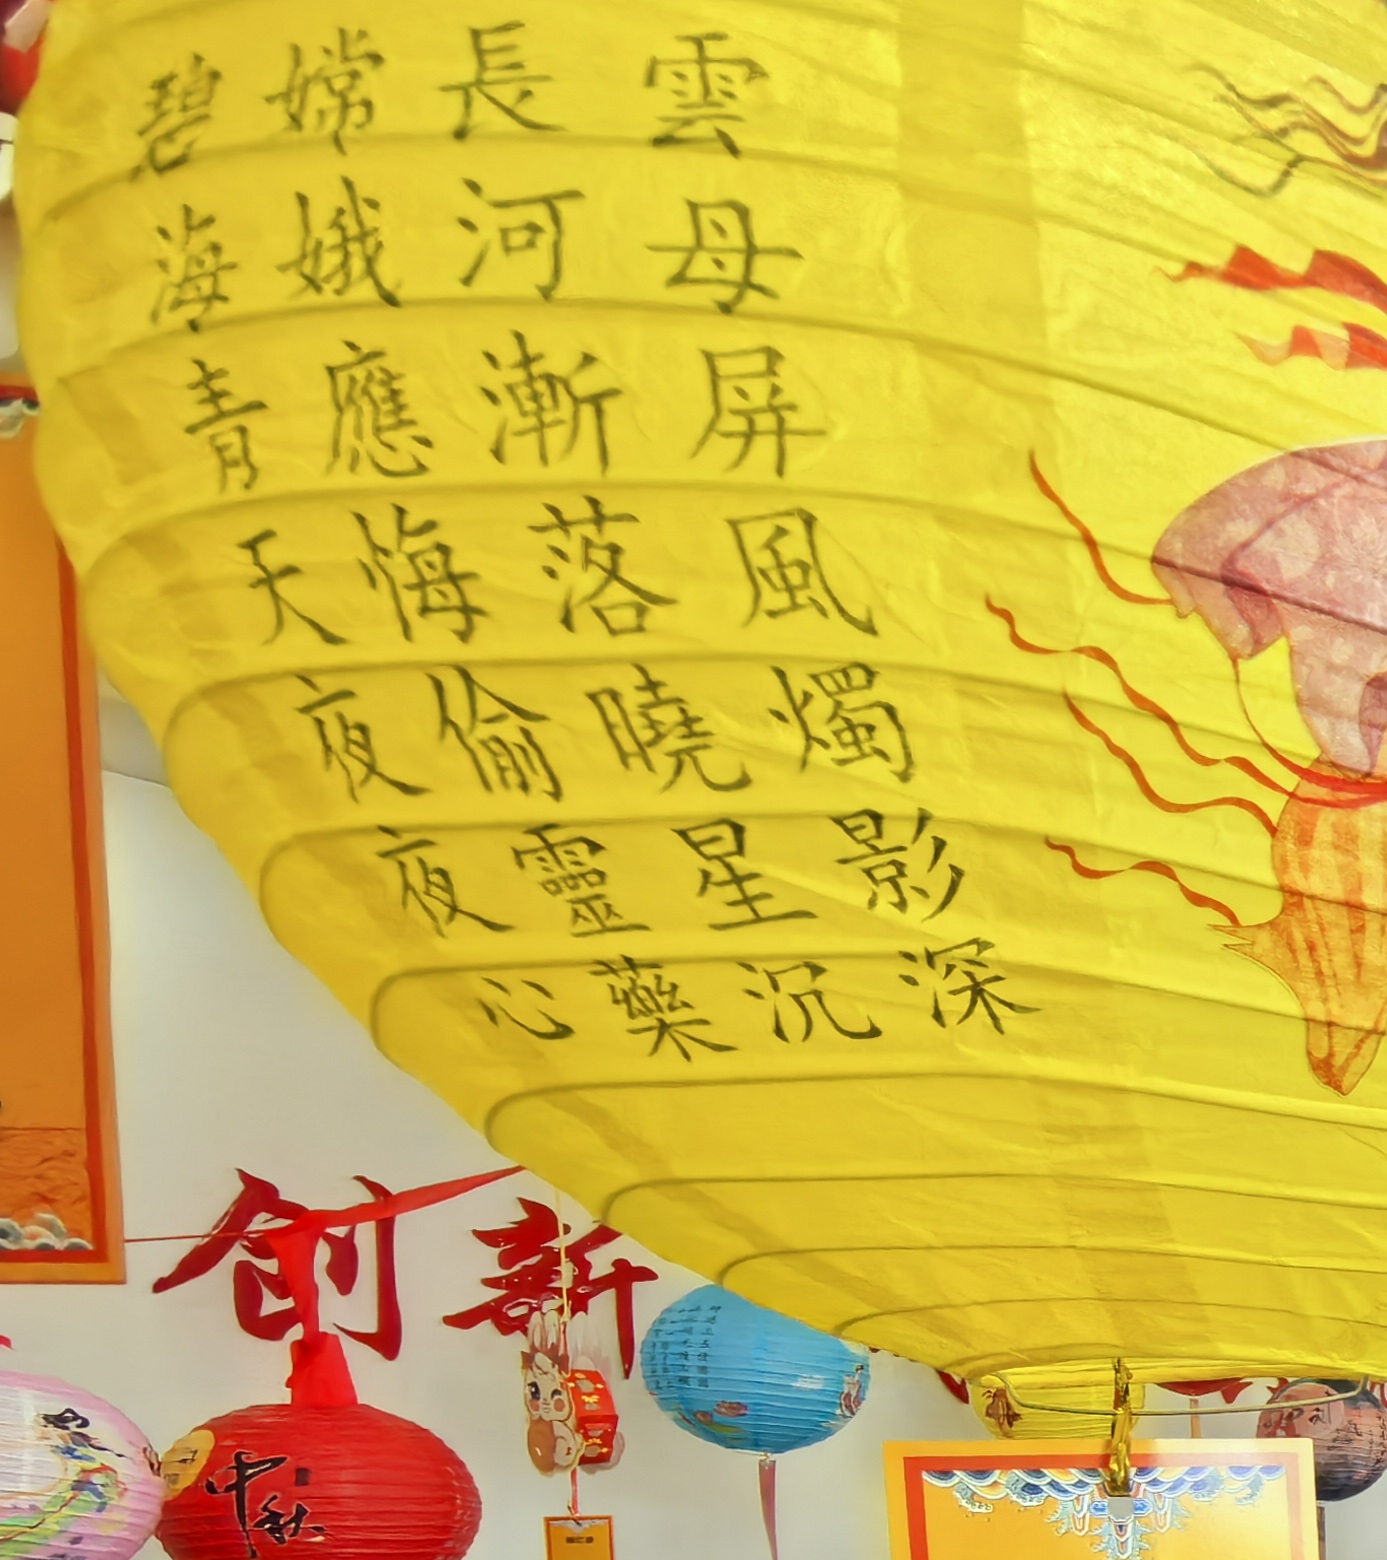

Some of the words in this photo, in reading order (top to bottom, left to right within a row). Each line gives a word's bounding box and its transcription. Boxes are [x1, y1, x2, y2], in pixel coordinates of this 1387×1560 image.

[129, 53, 575, 1041] 碧海青天夜夜心
[263, 26, 738, 1062] 嫦娥應悔偷靈藥
[440, 19, 884, 1046] 長河漸落曉星沉
[644, 30, 1042, 1035] 雲母屏風燭影深
